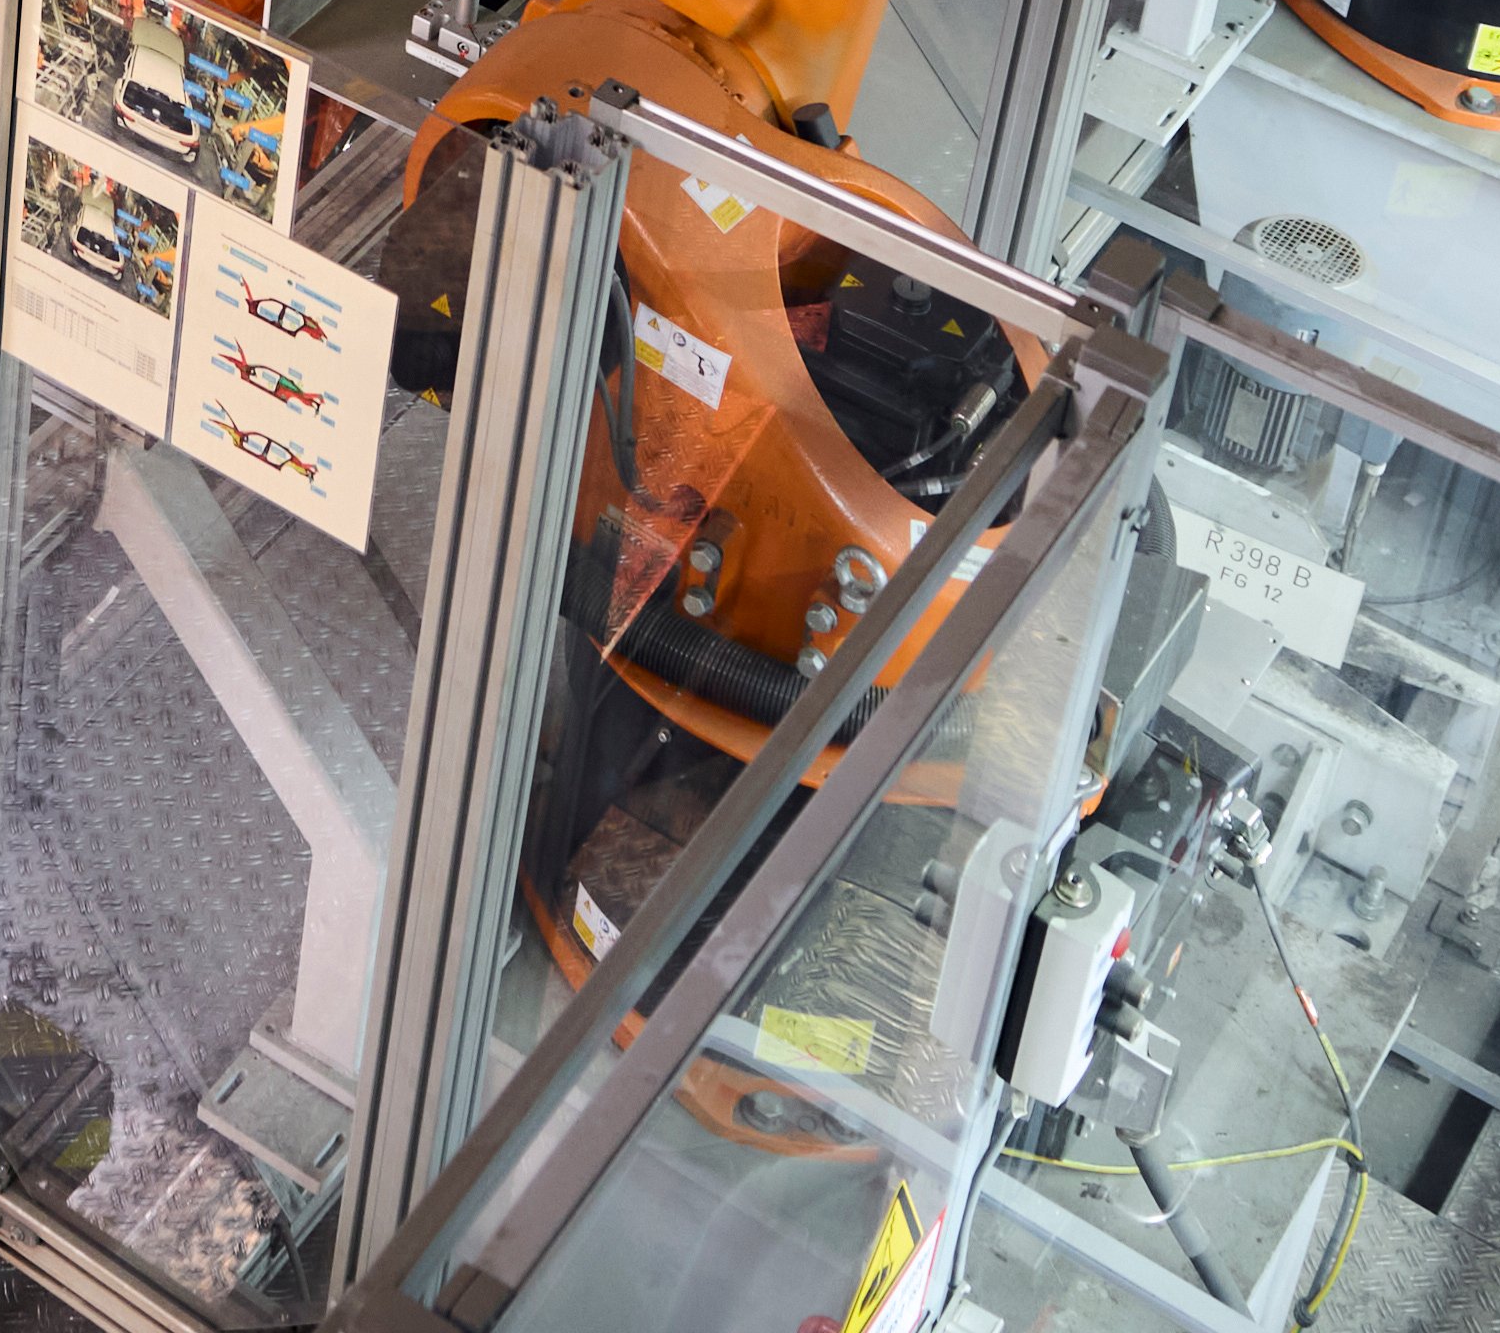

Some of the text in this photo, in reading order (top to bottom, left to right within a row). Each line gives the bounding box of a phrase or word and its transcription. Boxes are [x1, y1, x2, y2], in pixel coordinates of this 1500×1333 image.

[1205, 529, 1312, 589] R 398 B
[1220, 566, 1283, 604] FG 12
